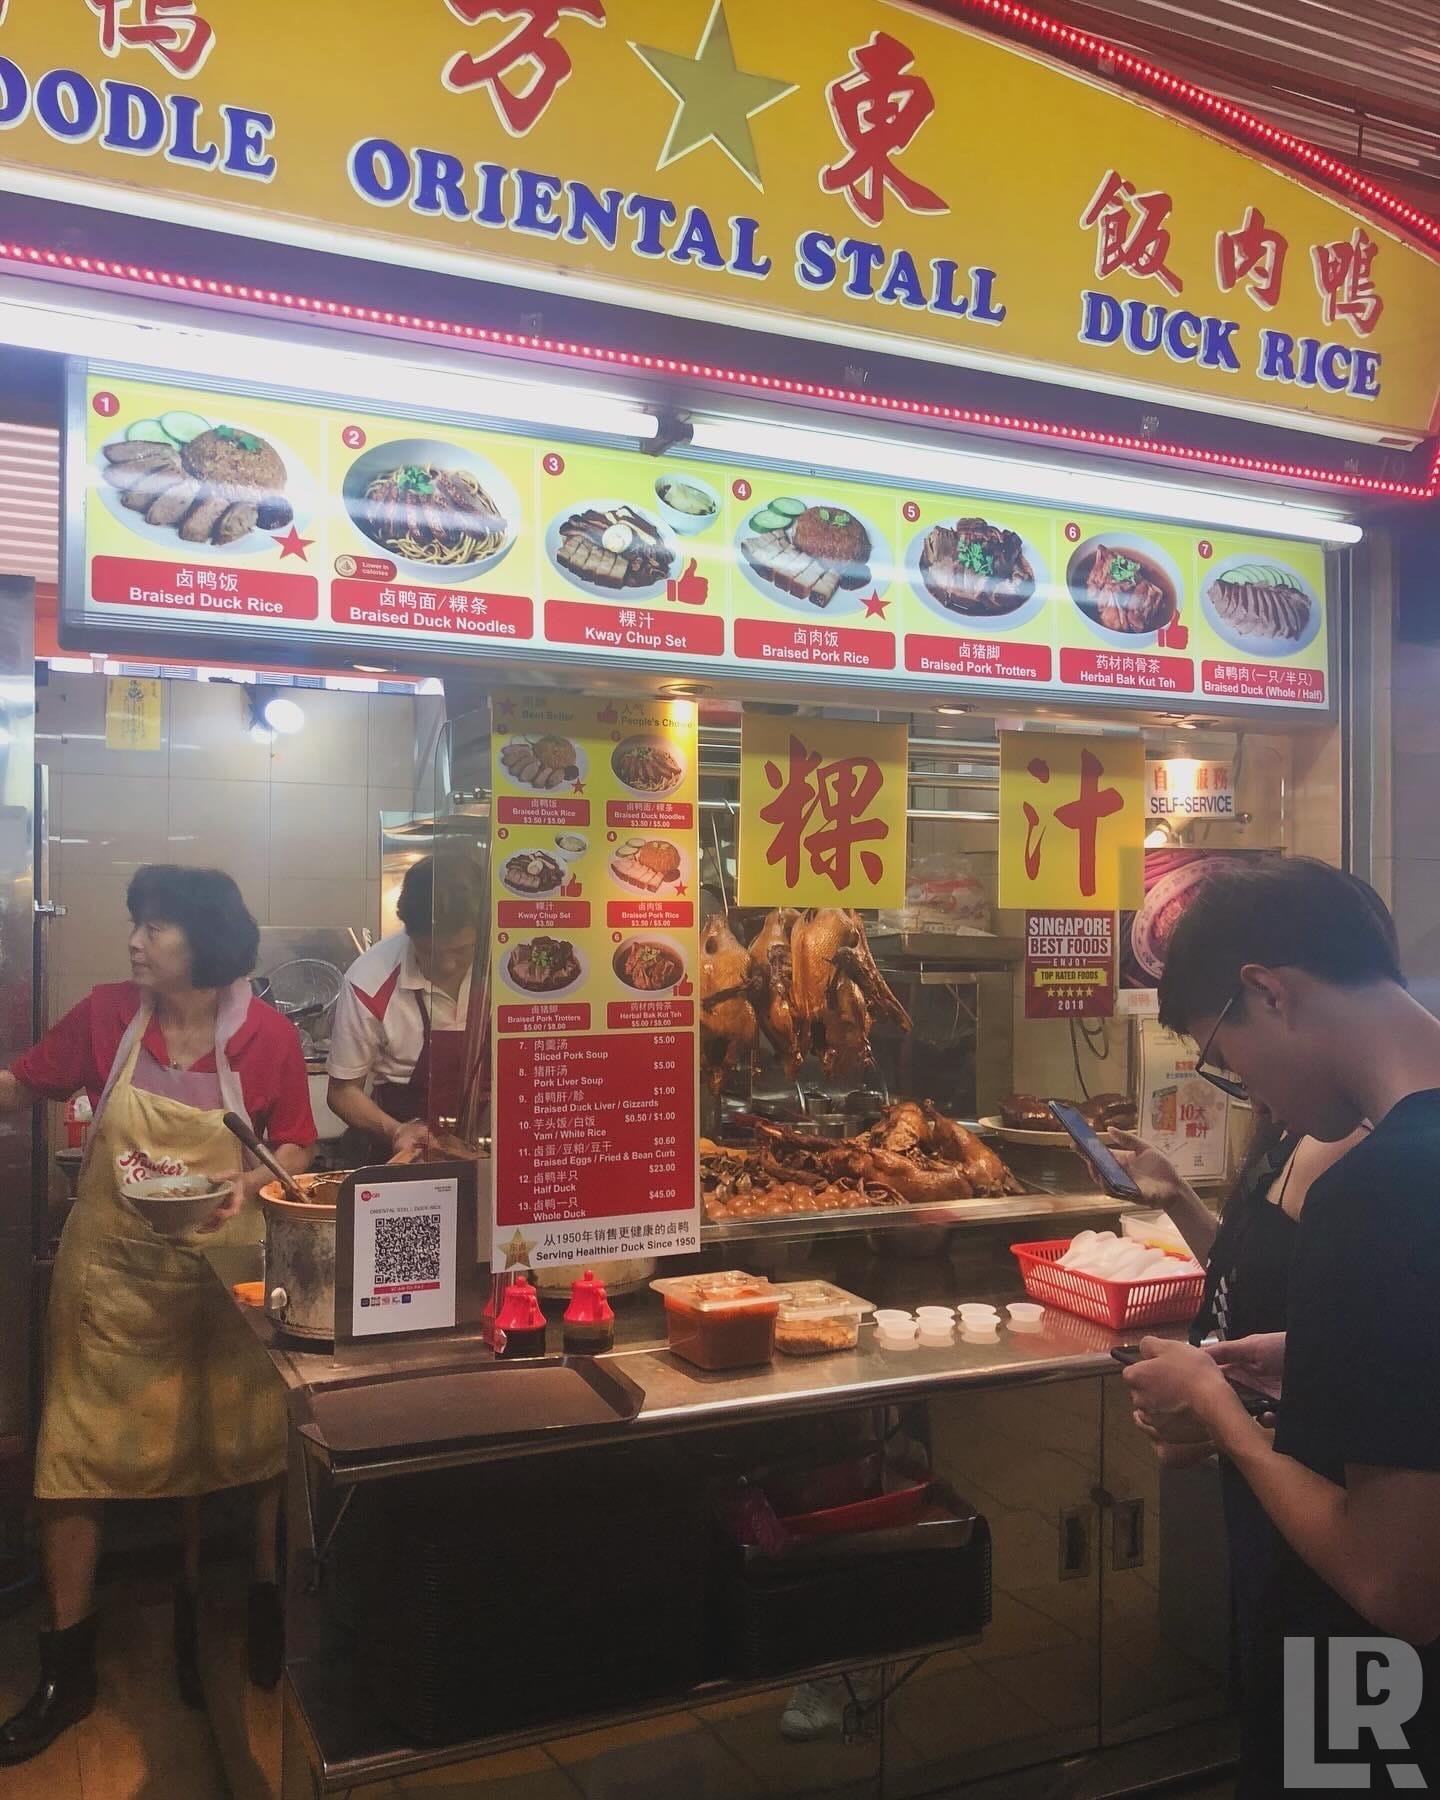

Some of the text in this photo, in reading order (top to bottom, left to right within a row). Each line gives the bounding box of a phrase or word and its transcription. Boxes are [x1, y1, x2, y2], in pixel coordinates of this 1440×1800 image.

[348, 137, 1007, 325] ORIENTAL STALL
[1080, 290, 1382, 400] DUCK RICE
[101, 397, 112, 413] 1
[348, 430, 360, 446] 2
[548, 458, 559, 471] 3
[737, 484, 747, 496] 4
[907, 505, 916, 519] 5
[1068, 525, 1077, 539] 6
[1201, 542, 1210, 556] 7
[176, 570, 239, 592] 卤鸭饭
[129, 586, 284, 614] Braised Duck Rice
[349, 607, 516, 635] Braised Duck Noodles
[618, 609, 655, 629] 粿汁
[585, 627, 687, 649] Kway Chup Set
[793, 627, 839, 648] 卤肉饭
[762, 645, 870, 665] Braised Pork Rice
[958, 642, 1000, 660] 卤猪脚
[920, 658, 1037, 678] Braised Pork Trotters
[1096, 655, 1161, 674] 药材肉骨茶
[1080, 670, 1176, 689] Herbal Bak Kut Teh
[1204, 680, 1238, 694] Braised
[1240, 683, 1263, 697] Duck
[1265, 685, 1297, 700] (Whole
[759, 734, 890, 891] 粿
[1150, 796, 1232, 814] SELF-SERVICE
[512, 808, 576, 818] Braised Duck Rice
[614, 811, 686, 821] Braised Duck Noodles
[1022, 748, 1125, 898] 汁
[518, 912, 571, 922] Kway Chup Set
[621, 911, 680, 920] Braised Pork Rice
[1029, 917, 1111, 936] SINGAPORE
[1030, 938, 1109, 954] BEST FOODS
[1041, 971, 1099, 980] TOP RATED FOODS
[1057, 1000, 1084, 1011] 2018
[507, 1014, 581, 1023] Braised Pork Trotters
[620, 1011, 643, 1020] Herbal
[653, 1036, 676, 1045] $5.00
[534, 1050, 609, 1061] Sliced Pork Soup
[653, 1061, 676, 1070] $5.00
[534, 1077, 604, 1088] Pork Liver Soup
[653, 1087, 676, 1095] $1.00
[534, 1099, 659, 1114] Braised Duck Liver Gizzards
[625, 1111, 676, 1123] $0.50 $1.00
[533, 1128, 607, 1141] Yam White Rice
[119, 1147, 183, 1176] Hawker
[533, 1158, 568, 1168] Braised
[569, 1156, 592, 1167] Eggs
[599, 1153, 621, 1162] Fried
[631, 1151, 654, 1160] Bean
[654, 1149, 676, 1159] Curb
[533, 1184, 577, 1195] Half Duck
[648, 1189, 676, 1200] $45.00
[533, 1210, 587, 1222] Whole Duck
[536, 1249, 574, 1262] Serving
[575, 1246, 620, 1258] Healthier
[621, 1242, 646, 1253] Duck
[647, 1240, 673, 1251] Since
[675, 1236, 696, 1247] 1950
